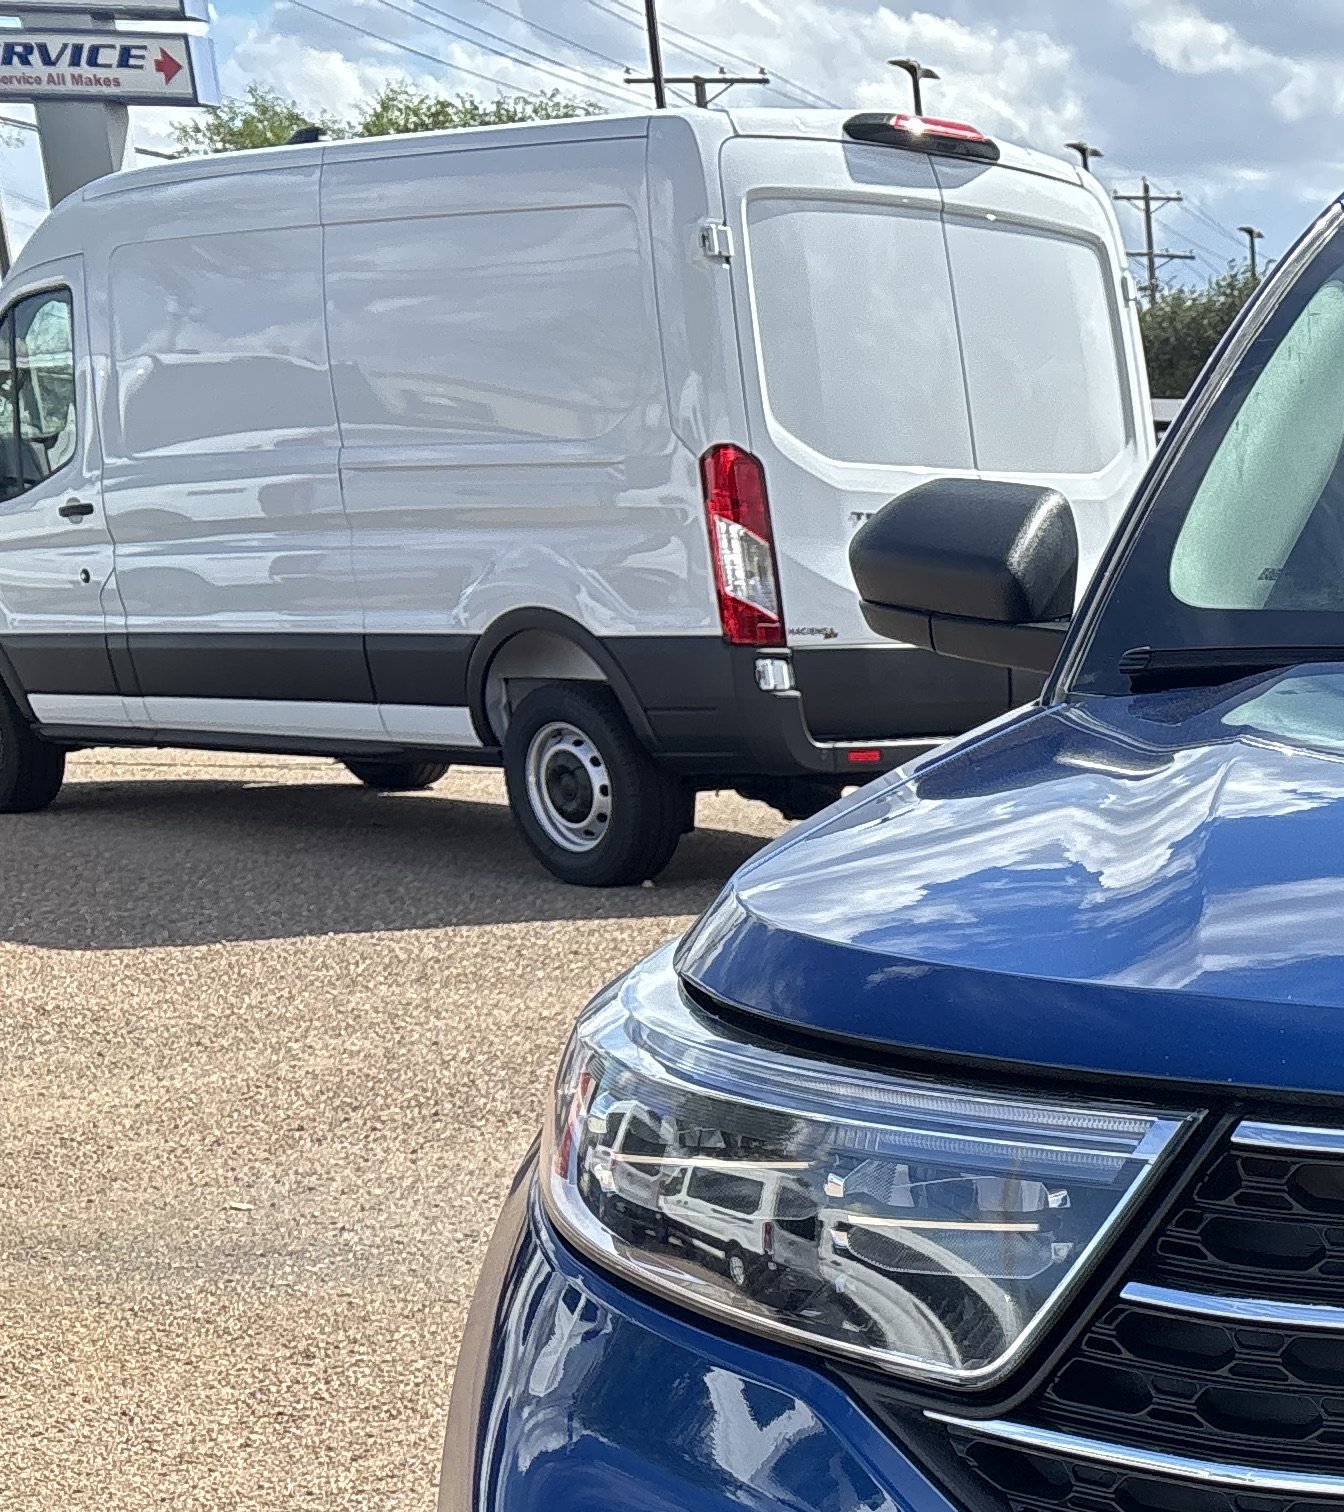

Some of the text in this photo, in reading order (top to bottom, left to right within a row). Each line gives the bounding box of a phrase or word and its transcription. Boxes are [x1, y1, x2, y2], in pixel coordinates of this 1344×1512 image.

[0, 42, 147, 69] RVICE
[0, 72, 121, 87] ervice All Makes
